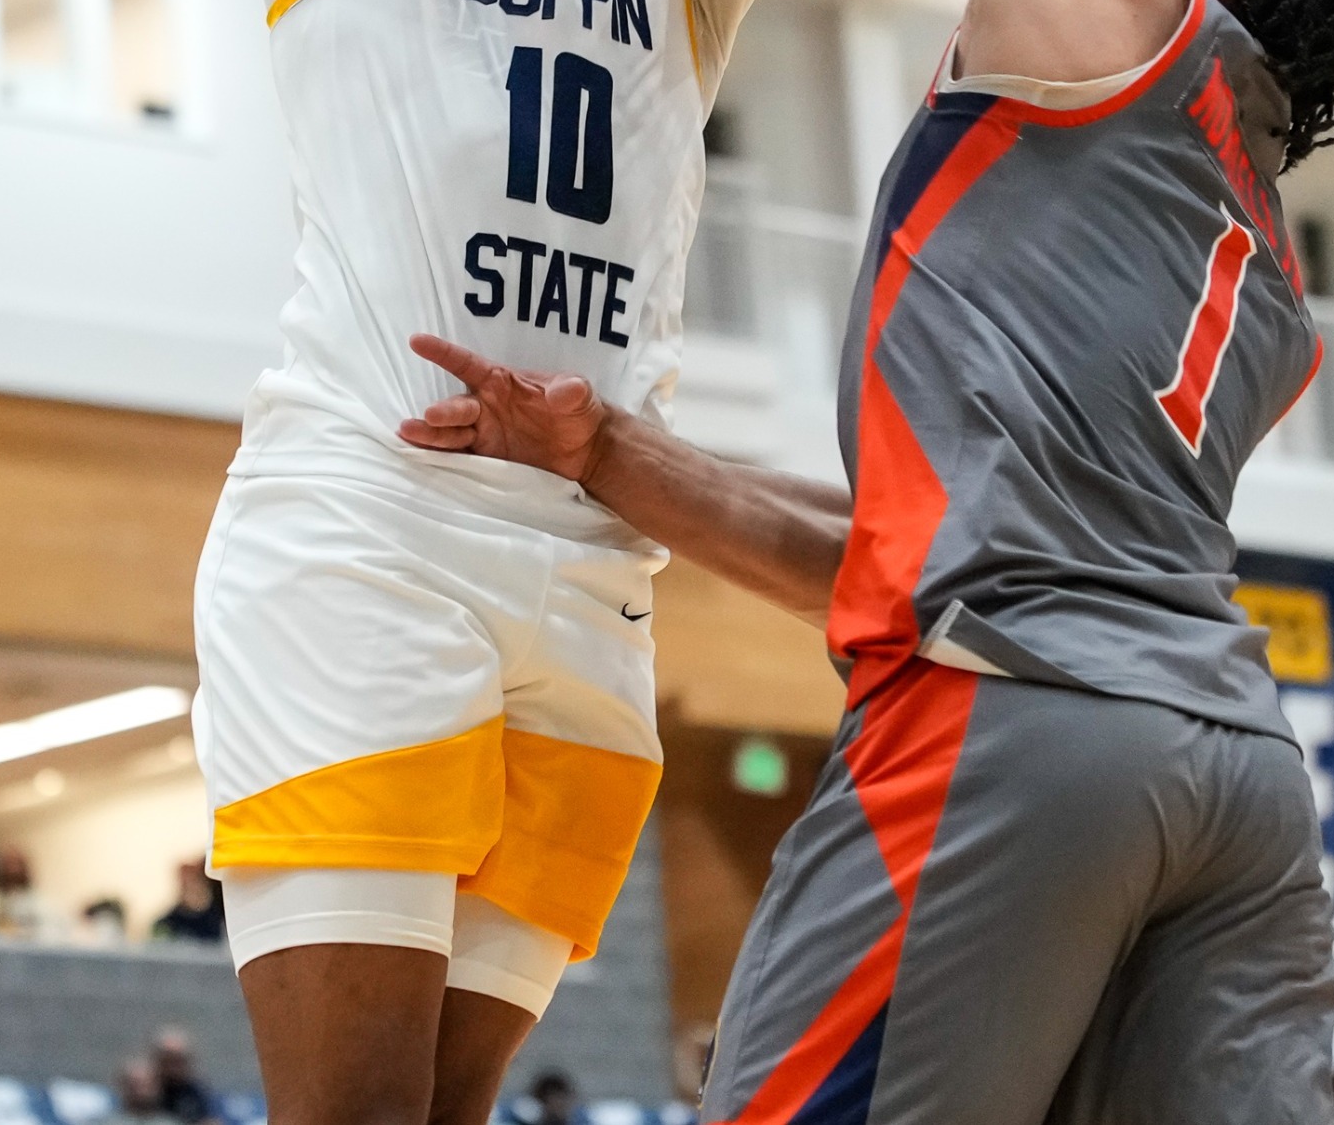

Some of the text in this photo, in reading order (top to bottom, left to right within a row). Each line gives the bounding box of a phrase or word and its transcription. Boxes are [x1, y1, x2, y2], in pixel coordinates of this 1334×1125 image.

[505, 46, 615, 225] 10
[463, 232, 635, 349] STATE
[1154, 200, 1258, 459] 1
